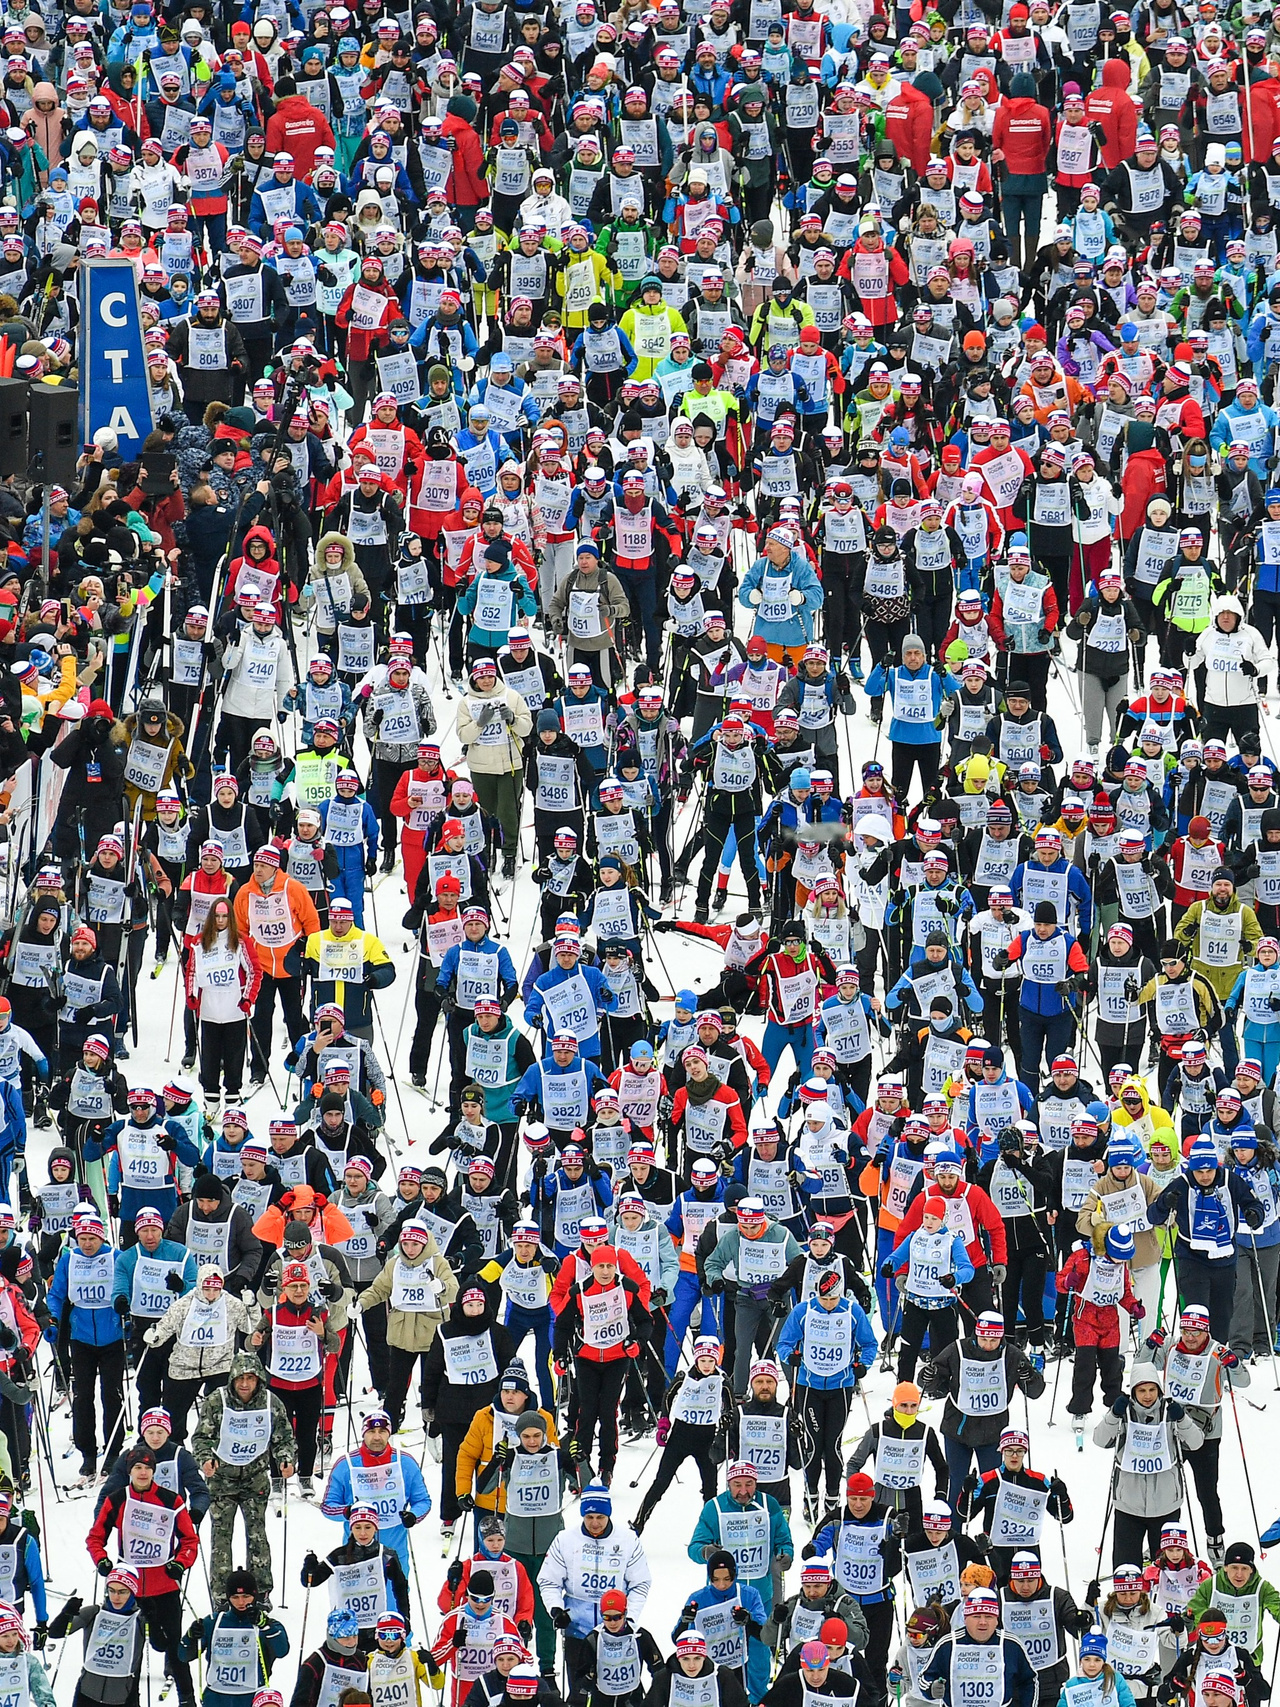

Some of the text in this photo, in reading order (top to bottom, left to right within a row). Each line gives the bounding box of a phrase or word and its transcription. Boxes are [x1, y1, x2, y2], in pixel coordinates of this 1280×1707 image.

[617, 258, 639, 269] 3847
[289, 284, 313, 296] 3488
[517, 277, 541, 289] 3958
[860, 278, 883, 289] 6070
[816, 312, 839, 323] 5534
[642, 337, 665, 348] 3642
[200, 354, 219, 364] 804
[390, 379, 415, 395] 4092
[469, 467, 494, 482] 5506
[425, 487, 450, 500] 3079
[1040, 511, 1066, 522] 5681
[622, 533, 646, 545] 1188
[833, 540, 858, 550] 7075
[871, 584, 897, 595] 3485
[1177, 594, 1201, 606] 3775
[482, 607, 500, 619] 652
[763, 604, 786, 615] 2169
[344, 655, 368, 667] 3246
[1213, 658, 1238, 672] 6014
[248, 662, 274, 676] 2140
[384, 715, 411, 731] 2263
[129, 768, 157, 788] 9965
[721, 772, 748, 786] 3406
[304, 786, 331, 799] 1958
[541, 786, 568, 801] 3486
[258, 922, 285, 936] 1439
[599, 919, 627, 933] 3365
[1208, 941, 1227, 954] 614
[207, 968, 235, 984] 1692
[328, 967, 355, 979] 1790
[1032, 963, 1054, 976] 655
[462, 981, 490, 994] 1783
[561, 1012, 588, 1028] 3782
[835, 1034, 860, 1048] 3717
[129, 1160, 157, 1174] 4193
[77, 1286, 105, 1299] 1110
[402, 1289, 424, 1301] 788
[810, 1347, 843, 1361] 3549
[278, 1357, 311, 1371] 2222
[462, 1369, 487, 1383] 703
[969, 1394, 998, 1408] 1190
[682, 1409, 712, 1423] 3972
[231, 1442, 256, 1454] 848
[748, 1448, 780, 1464] 1725
[1132, 1458, 1162, 1472] 1900
[517, 1486, 549, 1500] 1570
[129, 1539, 162, 1558] 1208
[733, 1546, 762, 1563] 1671
[843, 1561, 876, 1580] 3303
[582, 1574, 616, 1588] 2684
[345, 1595, 378, 1612] 1987
[461, 1649, 494, 1664] 2201
[216, 1666, 246, 1682] 1501
[603, 1664, 634, 1681] 2481
[375, 1684, 409, 1702] 2401
[960, 1682, 994, 1698] 1303
